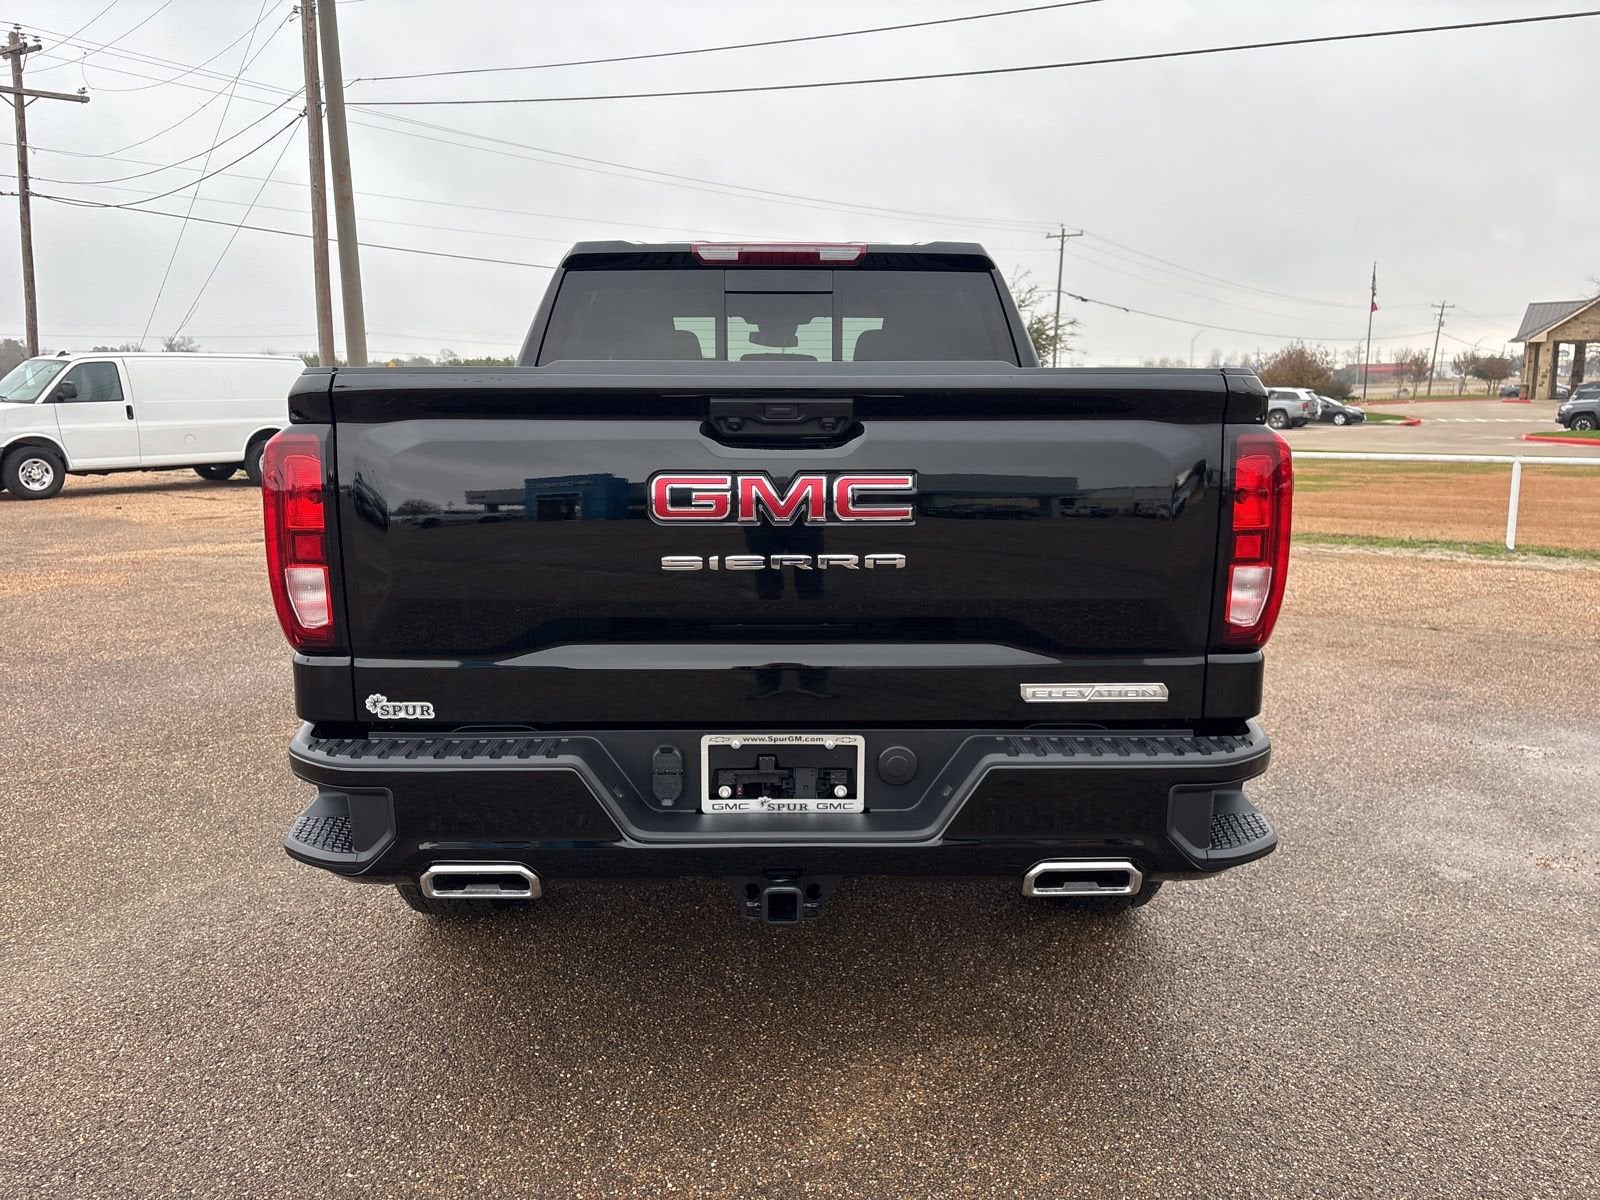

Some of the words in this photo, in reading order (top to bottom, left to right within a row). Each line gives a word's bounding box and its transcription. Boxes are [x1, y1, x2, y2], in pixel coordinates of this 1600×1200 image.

[651, 475, 914, 521] GMC
[661, 554, 907, 571] SIERRA
[1032, 689, 1159, 698] ELEVATION
[380, 705, 432, 716] SPUR
[767, 803, 808, 812] SPUR
[816, 802, 854, 810] GMC
